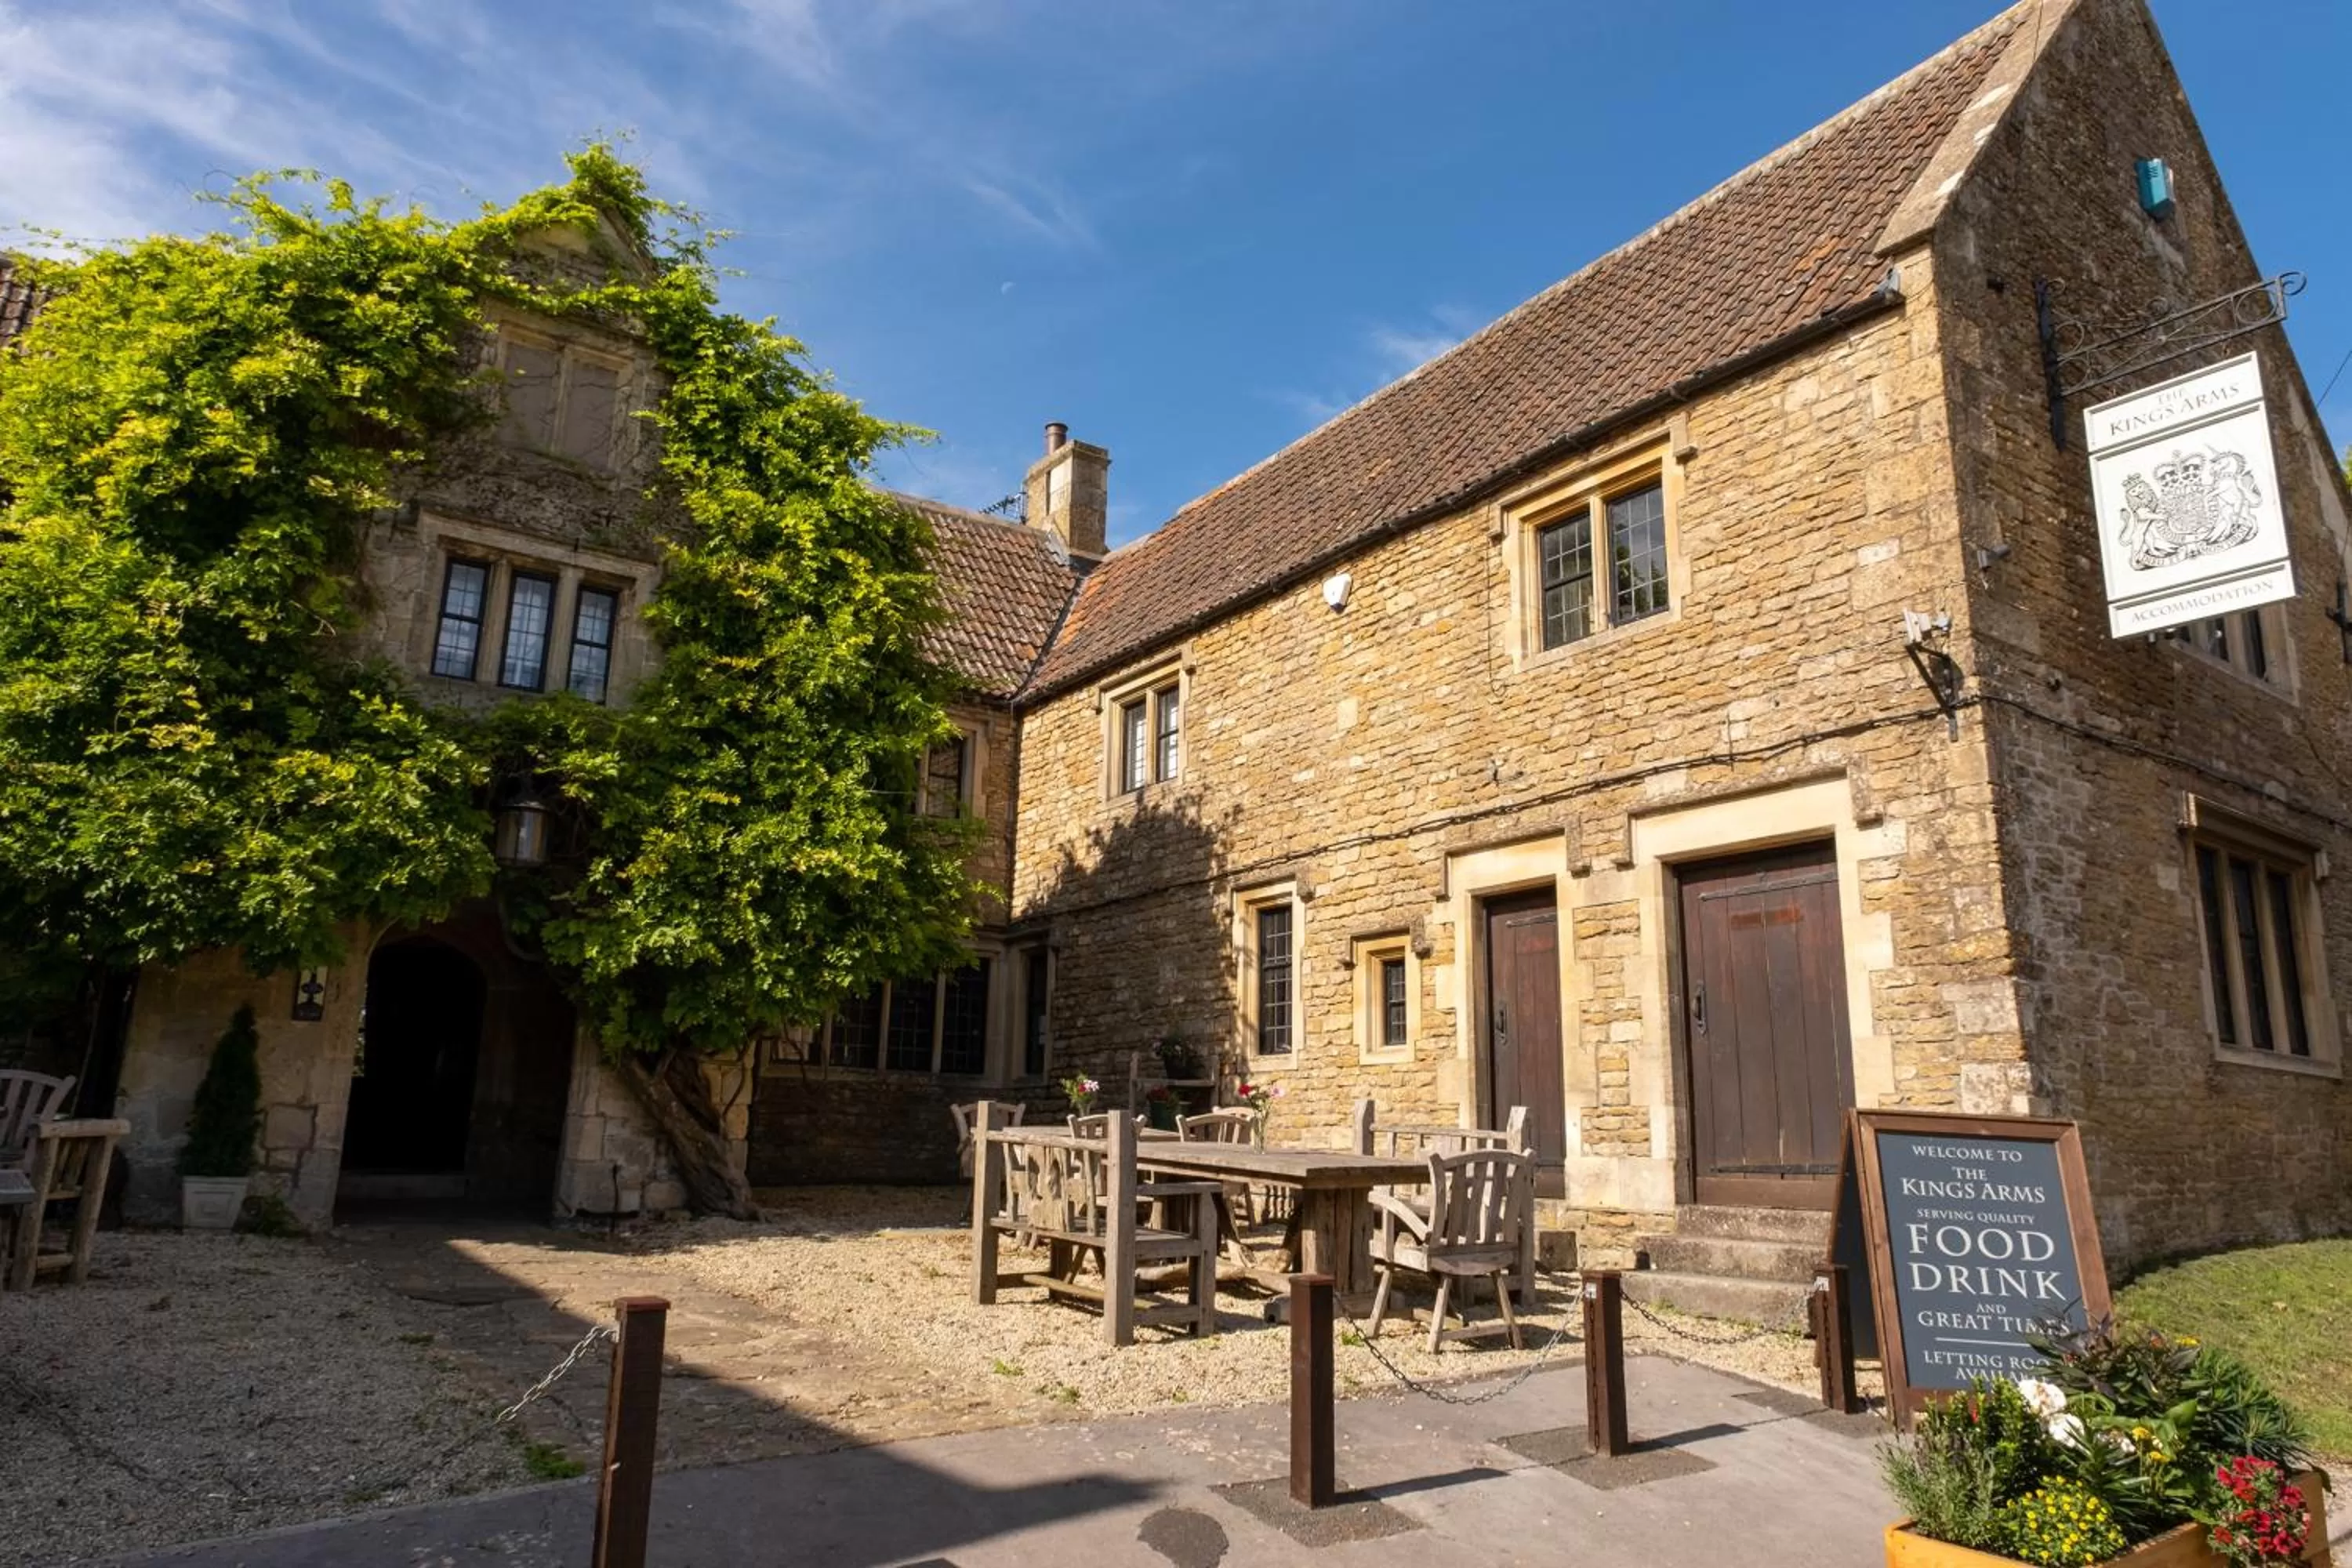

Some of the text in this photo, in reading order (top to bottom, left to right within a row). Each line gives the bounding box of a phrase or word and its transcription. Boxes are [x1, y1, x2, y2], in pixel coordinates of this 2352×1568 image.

[2110, 382, 2240, 437] KINGS ARMS
[2131, 579, 2274, 623] ACCOMMODATION
[1911, 1145, 2023, 1163] WELCOME TO
[1951, 1166, 1988, 1181] THE
[1900, 1177, 2045, 1203] KINGS ARMS
[1917, 1208, 2035, 1225] SERVING QUALITY
[1906, 1222, 2055, 1262] FOOD
[1907, 1261, 2067, 1301] DRINK
[1976, 1302, 2007, 1315] AND
[1918, 1310, 1992, 1330] GREAT
[1923, 1349, 2052, 1370] LETTING ROO
